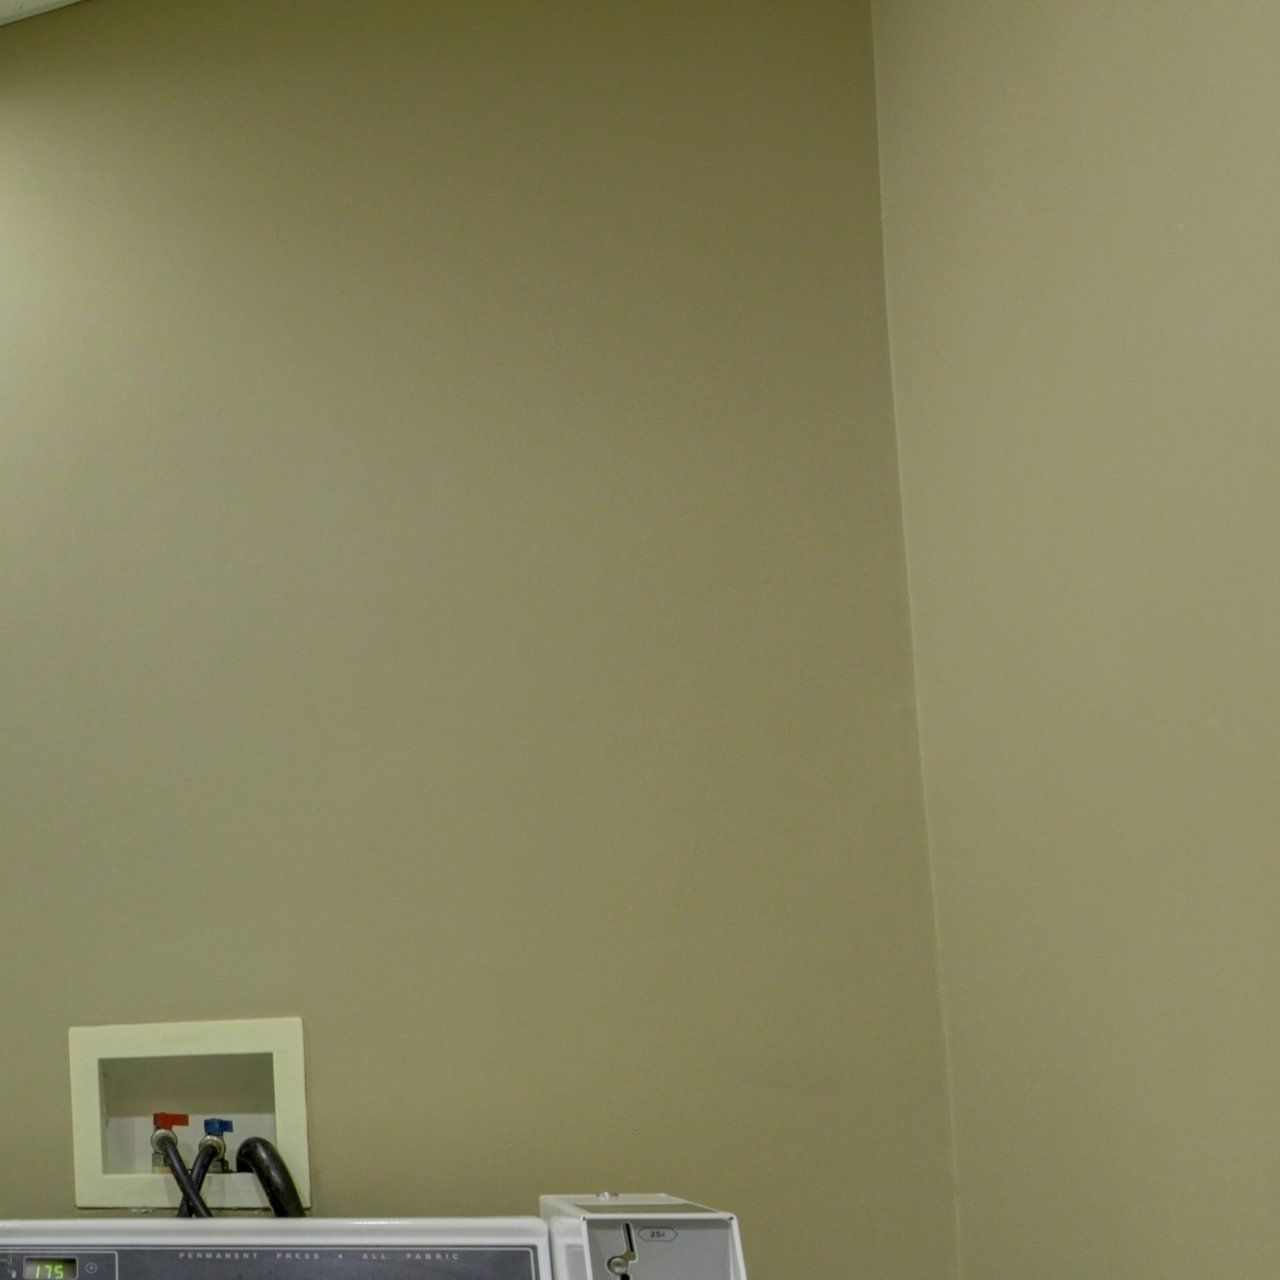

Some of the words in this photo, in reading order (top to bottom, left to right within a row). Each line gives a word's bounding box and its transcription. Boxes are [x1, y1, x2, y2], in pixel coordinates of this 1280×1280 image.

[178, 1252, 259, 1260] PERMANENT
[276, 1252, 320, 1260] PRESS
[34, 1264, 64, 1280] 175
